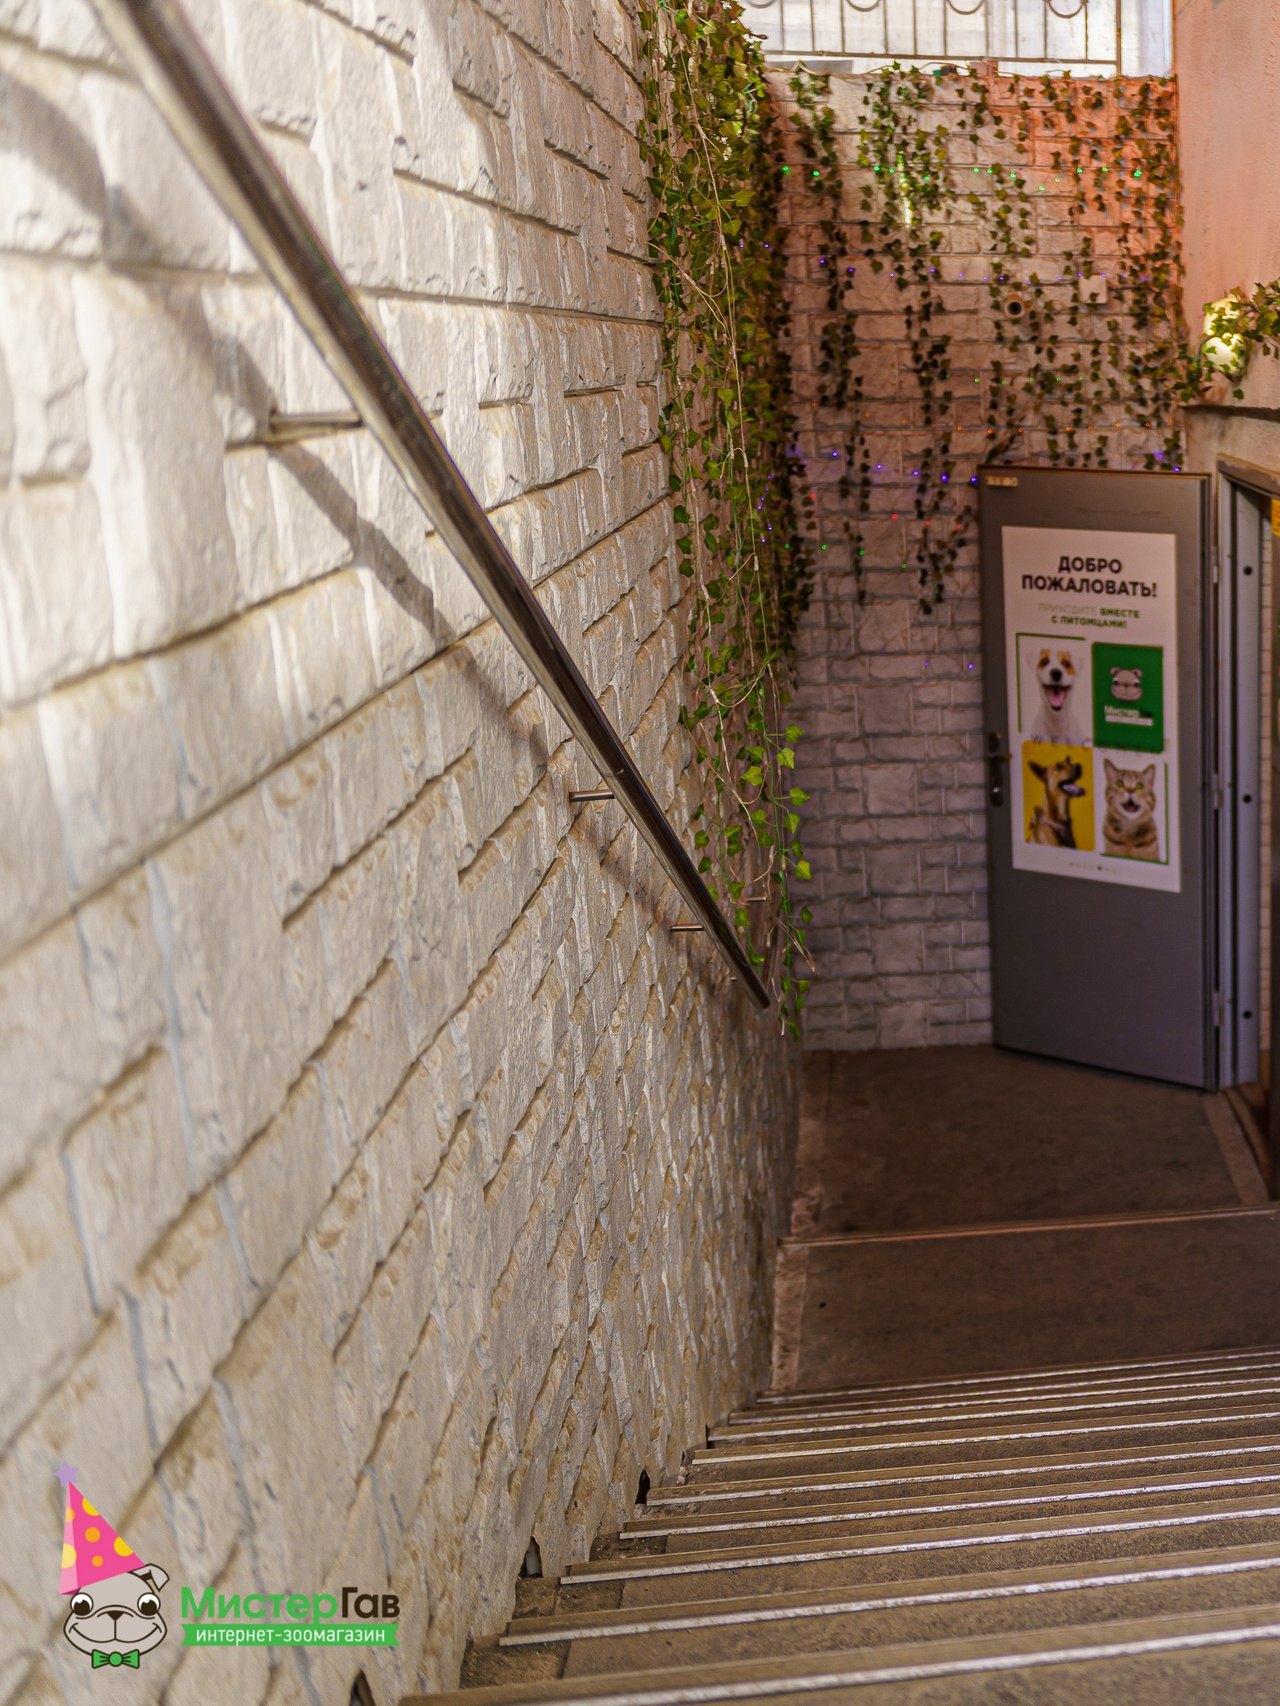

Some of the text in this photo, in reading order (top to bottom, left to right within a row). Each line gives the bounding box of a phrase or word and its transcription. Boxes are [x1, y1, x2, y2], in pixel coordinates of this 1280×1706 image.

[1058, 556, 1122, 574] ДОБРО
[1021, 574, 1157, 598] ПОЖАЛОВАТЬ!
[1100, 608, 1140, 618] ВМЕСТЕ
[1051, 615, 1127, 628] С ПИТОМЦАМИ!
